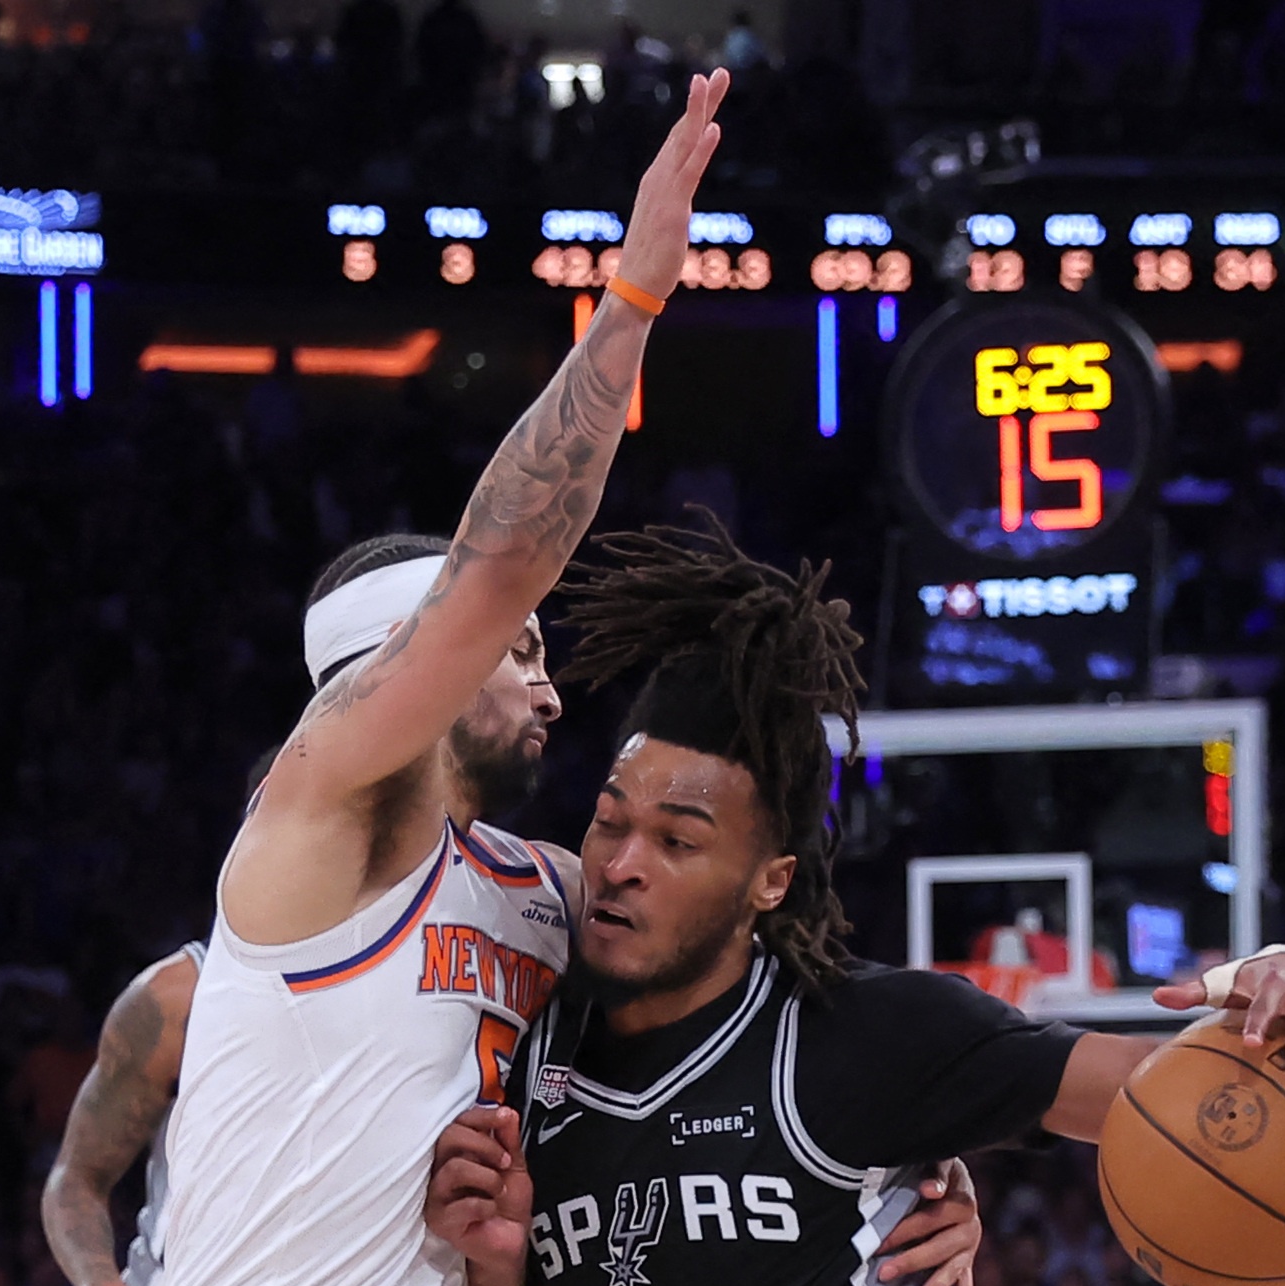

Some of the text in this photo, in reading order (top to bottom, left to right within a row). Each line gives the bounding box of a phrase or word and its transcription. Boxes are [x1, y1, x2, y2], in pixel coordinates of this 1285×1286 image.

[975, 342, 1111, 417] 6:25
[999, 411, 1102, 532] 15
[976, 574, 1137, 618] TISSOT
[416, 922, 497, 1001] NEW
[681, 1115, 744, 1136] LEDGER
